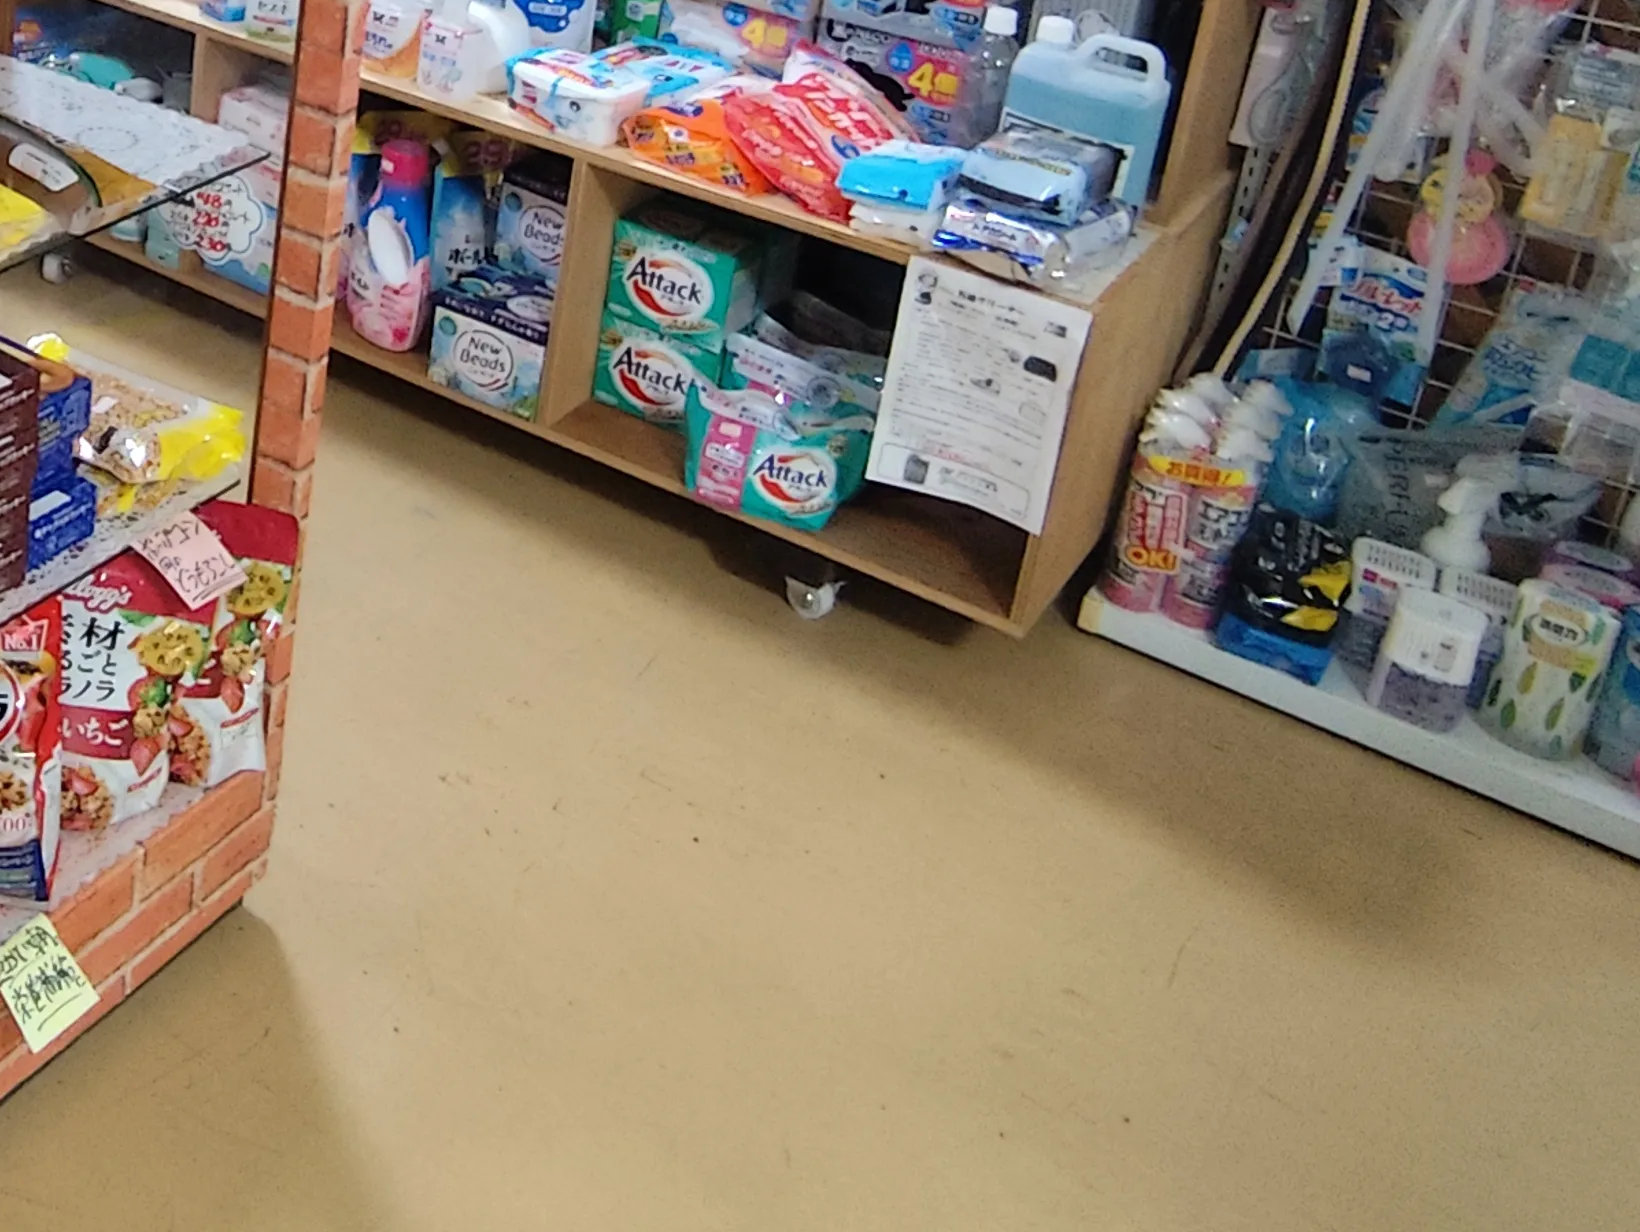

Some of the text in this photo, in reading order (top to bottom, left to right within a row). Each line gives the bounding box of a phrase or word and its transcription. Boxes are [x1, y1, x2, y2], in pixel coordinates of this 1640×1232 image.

[532, 211, 564, 229] New
[626, 255, 702, 305] Attack
[459, 349, 506, 375] Beads
[468, 336, 502, 357] New
[612, 346, 687, 396] Attack
[753, 453, 829, 489] Attack
[63, 717, 128, 748] いちご
